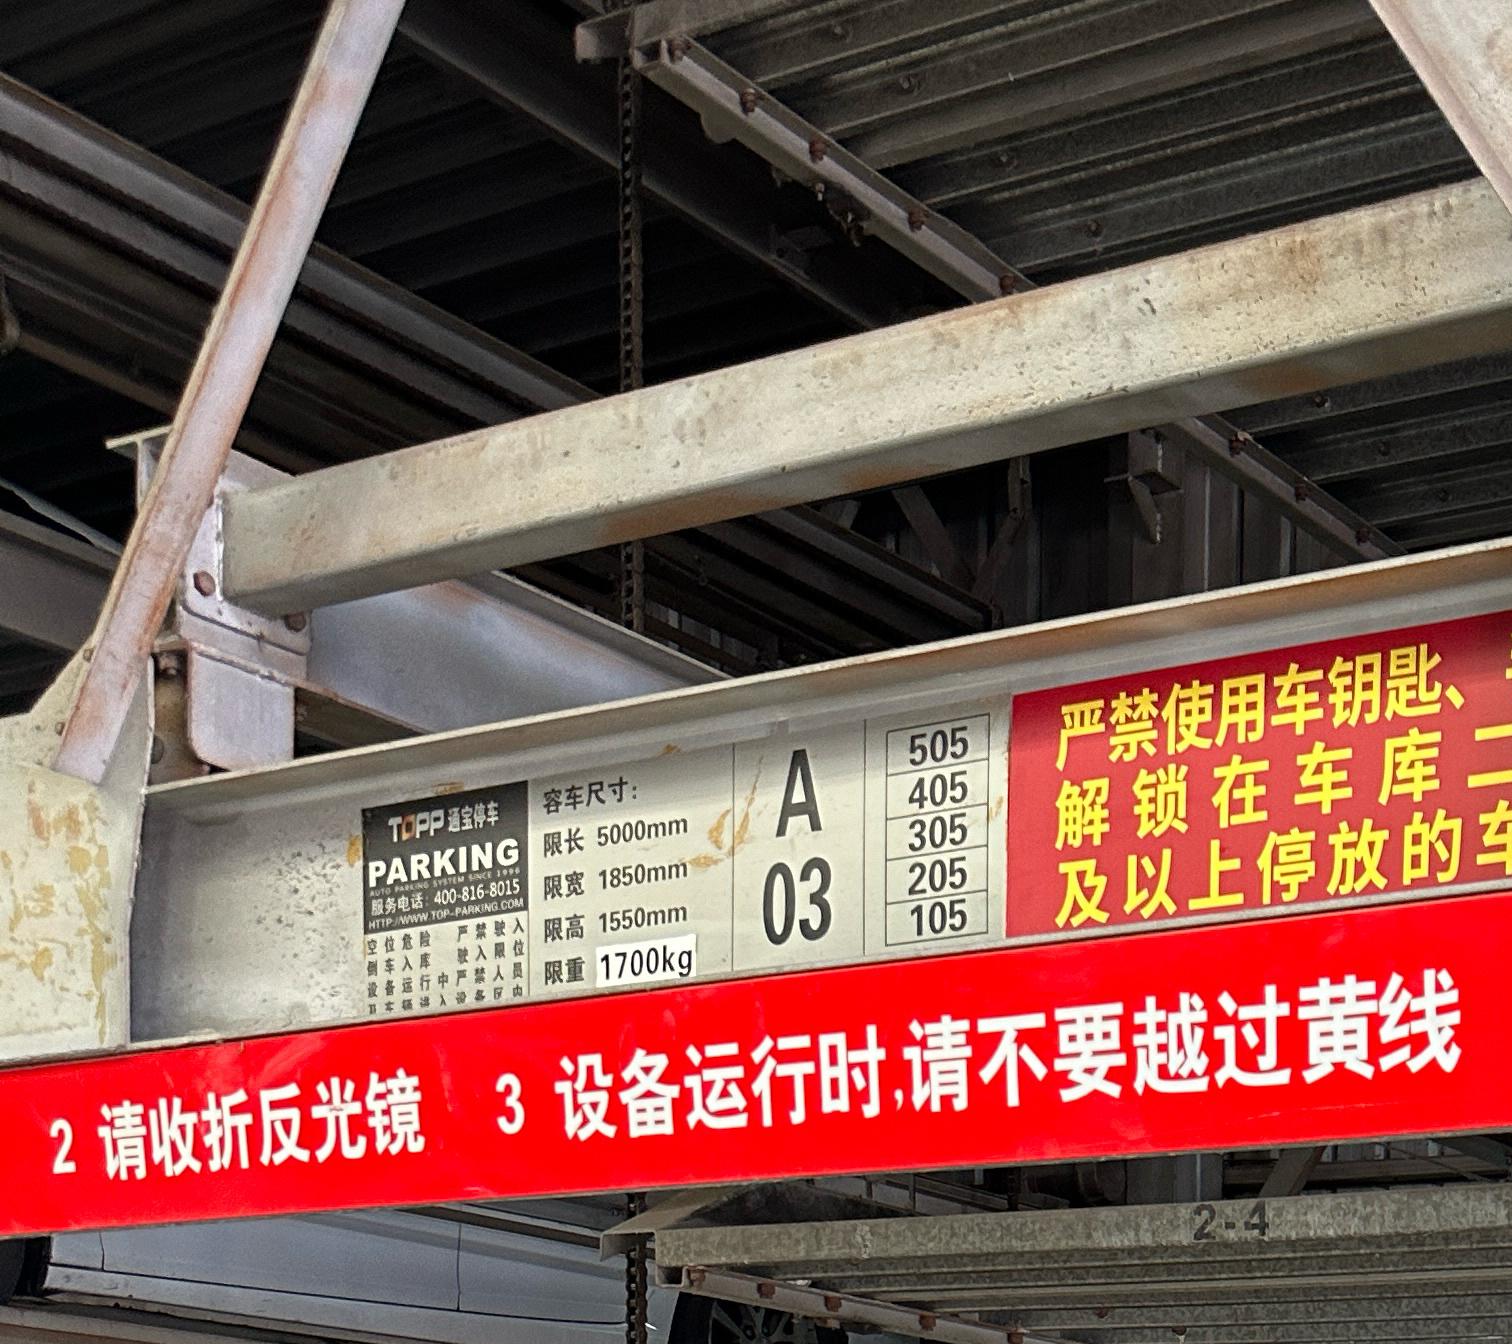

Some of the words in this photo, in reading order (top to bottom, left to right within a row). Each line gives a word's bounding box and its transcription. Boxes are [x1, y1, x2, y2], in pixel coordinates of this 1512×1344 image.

[909, 726, 969, 767] 505
[776, 748, 822, 838] A
[908, 770, 968, 809] 405
[388, 809, 445, 842] TOPP
[543, 827, 585, 858] 限长
[597, 817, 688, 847] 5000mm
[908, 812, 968, 852] 305
[368, 838, 519, 888] PARKING
[543, 870, 585, 900] 限宽
[598, 862, 688, 890] 1850mm
[908, 856, 968, 895] 205
[434, 878, 520, 905] 400-816-8015
[763, 857, 832, 945] 03
[544, 914, 585, 943] 限高
[598, 905, 688, 933] 1550mm
[910, 898, 968, 937] 105
[544, 957, 585, 986] 限重
[600, 945, 692, 980] 1700kg
[50, 1118, 77, 1175] 2
[98, 1068, 426, 1181] 请收折反光镜
[496, 1073, 525, 1135] 3
[1193, 1200, 1270, 1241] 2-4
